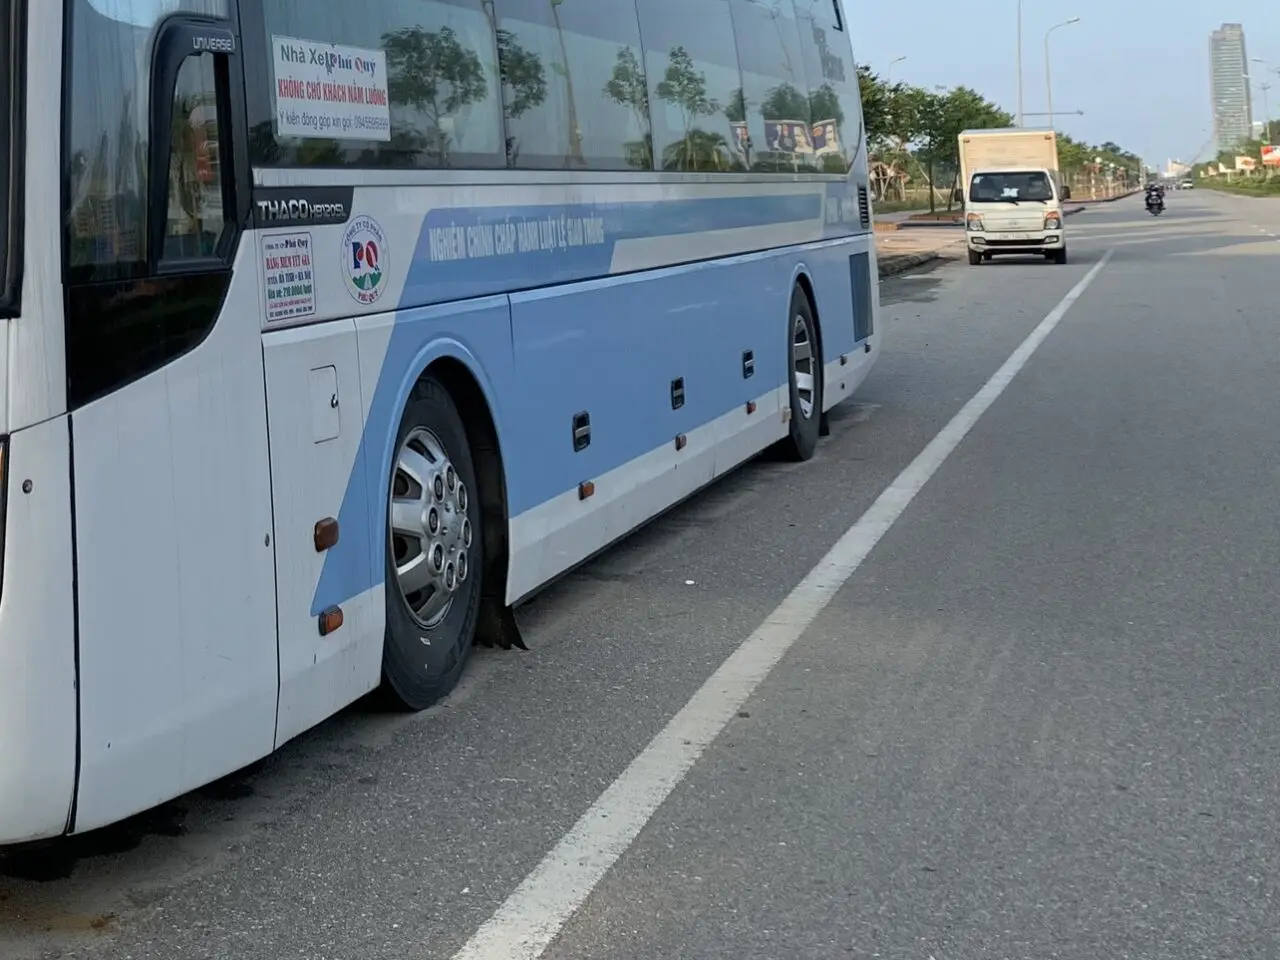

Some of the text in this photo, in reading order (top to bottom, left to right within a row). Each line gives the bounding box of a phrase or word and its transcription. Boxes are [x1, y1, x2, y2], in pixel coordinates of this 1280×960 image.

[192, 37, 232, 50] UNIVERSE
[281, 44, 306, 63] Nhà
[309, 48, 325, 66] Xe
[278, 76, 305, 99] KHÔNG
[323, 80, 347, 102] KHÁCH
[257, 199, 308, 220] THACO
[429, 221, 467, 262] NGHIÊM
